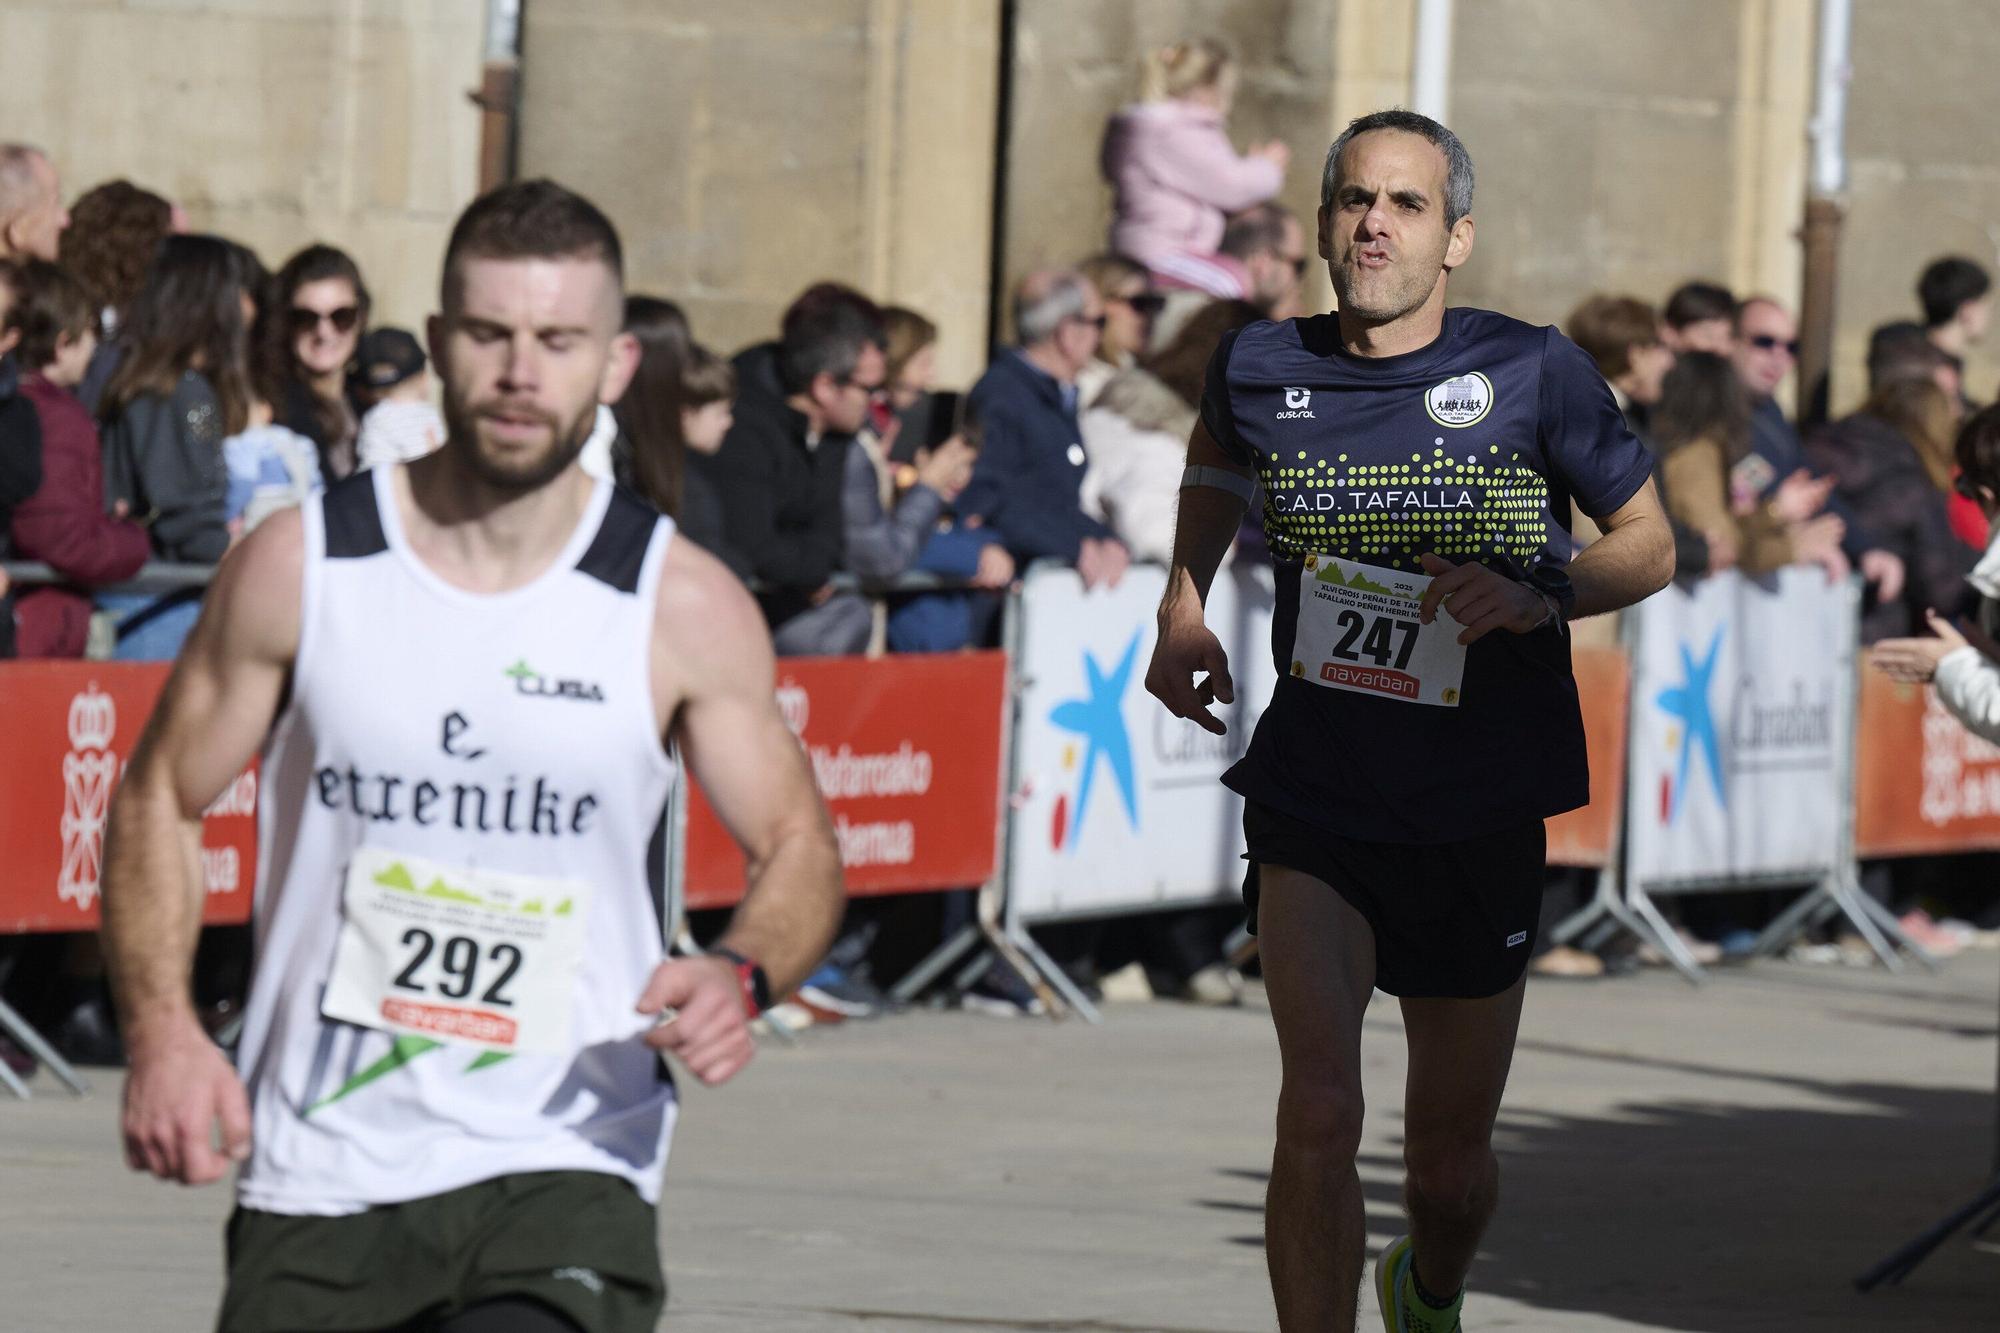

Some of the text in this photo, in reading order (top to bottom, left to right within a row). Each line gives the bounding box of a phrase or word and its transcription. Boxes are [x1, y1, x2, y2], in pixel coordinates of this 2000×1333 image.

[1276, 410, 1316, 419] austral
[1274, 490, 1474, 512] C.A.D. TAFALLA
[1320, 583, 1338, 594] XLVI
[1338, 588, 1360, 599] CROSS
[1362, 592, 1388, 604] PEÑAS
[1390, 598, 1401, 607] DE
[1394, 582, 1414, 592] 2025
[1314, 591, 1356, 607] TAFALLAKO
[1357, 601, 1384, 613] PEÑEN
[1385, 606, 1410, 618] HERRI
[1332, 609, 1420, 670] 247
[1326, 665, 1414, 694] navarban
[316, 763, 600, 837] etxenike
[393, 927, 524, 1007] 292
